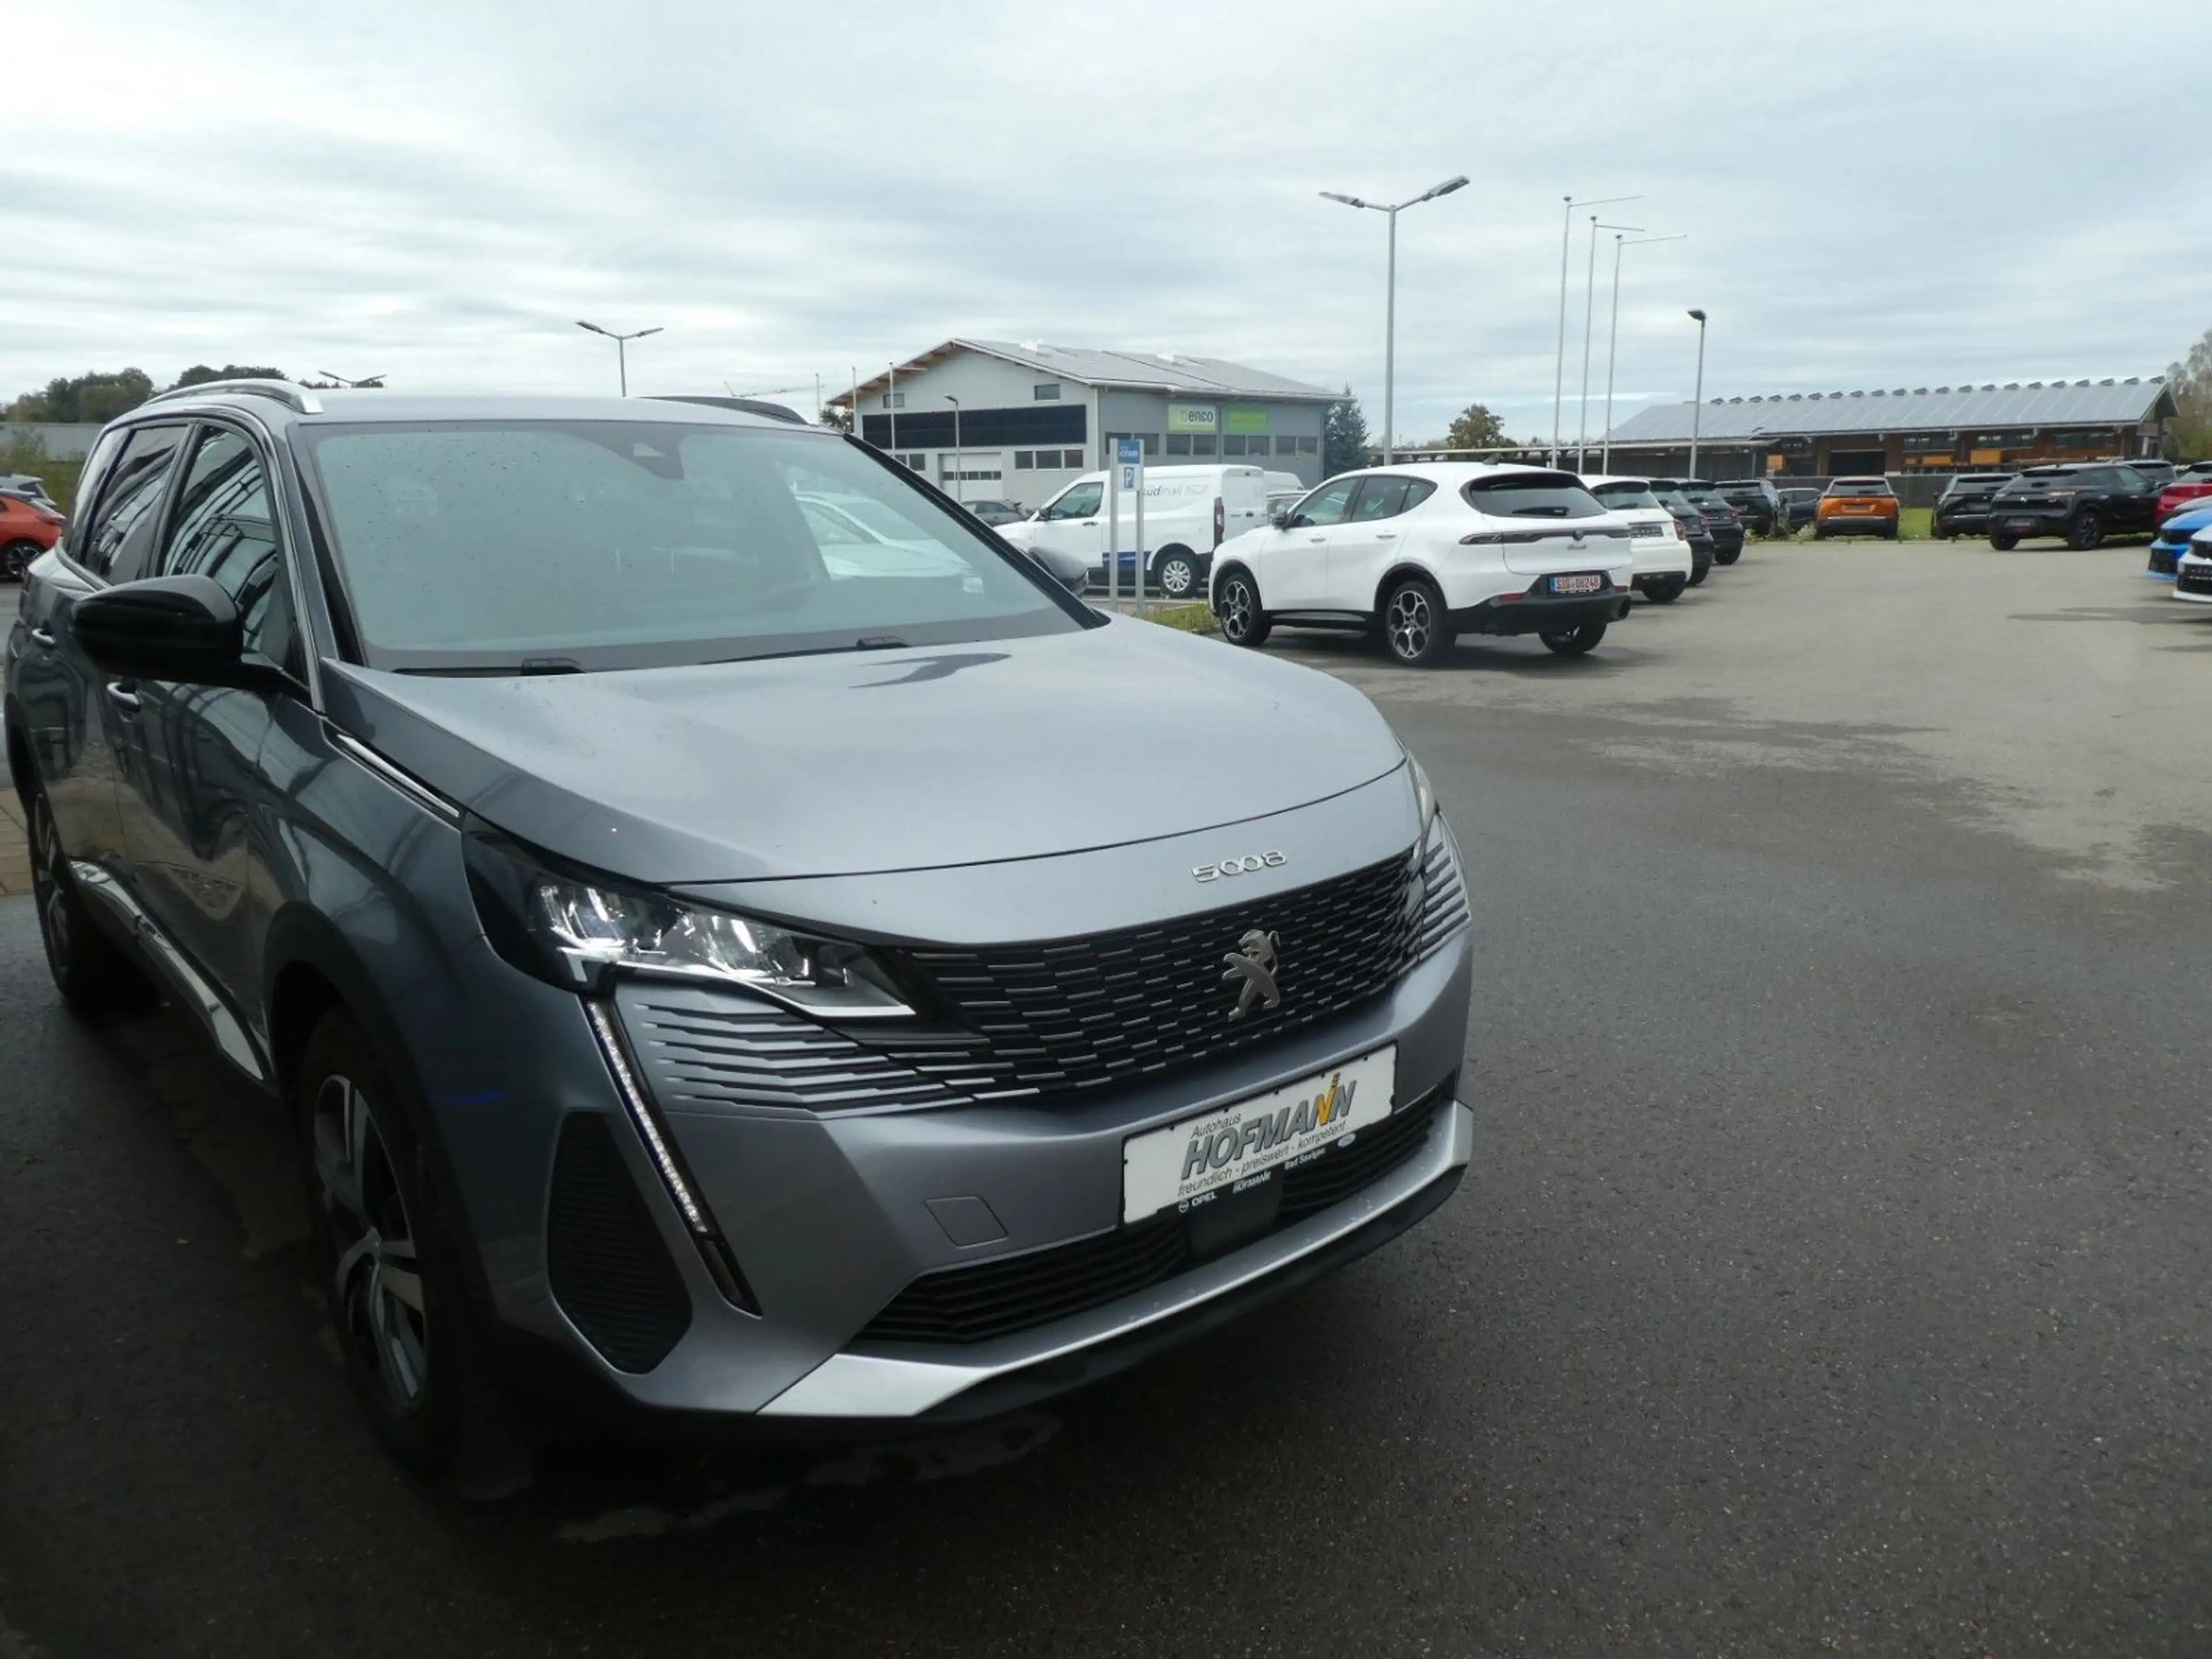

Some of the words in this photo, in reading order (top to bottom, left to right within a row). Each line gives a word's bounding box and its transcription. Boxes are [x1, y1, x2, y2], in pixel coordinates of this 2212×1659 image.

[1192, 850, 1286, 883] 5008
[1181, 1078, 1357, 1180] HOFMANN
[1190, 1113, 1241, 1141] Autohaus
[1178, 1166, 1233, 1197] freundlich
[1241, 1145, 1290, 1175] preiswert
[1297, 1119, 1346, 1150] kompetent
[1191, 1191, 1218, 1207] OPEL
